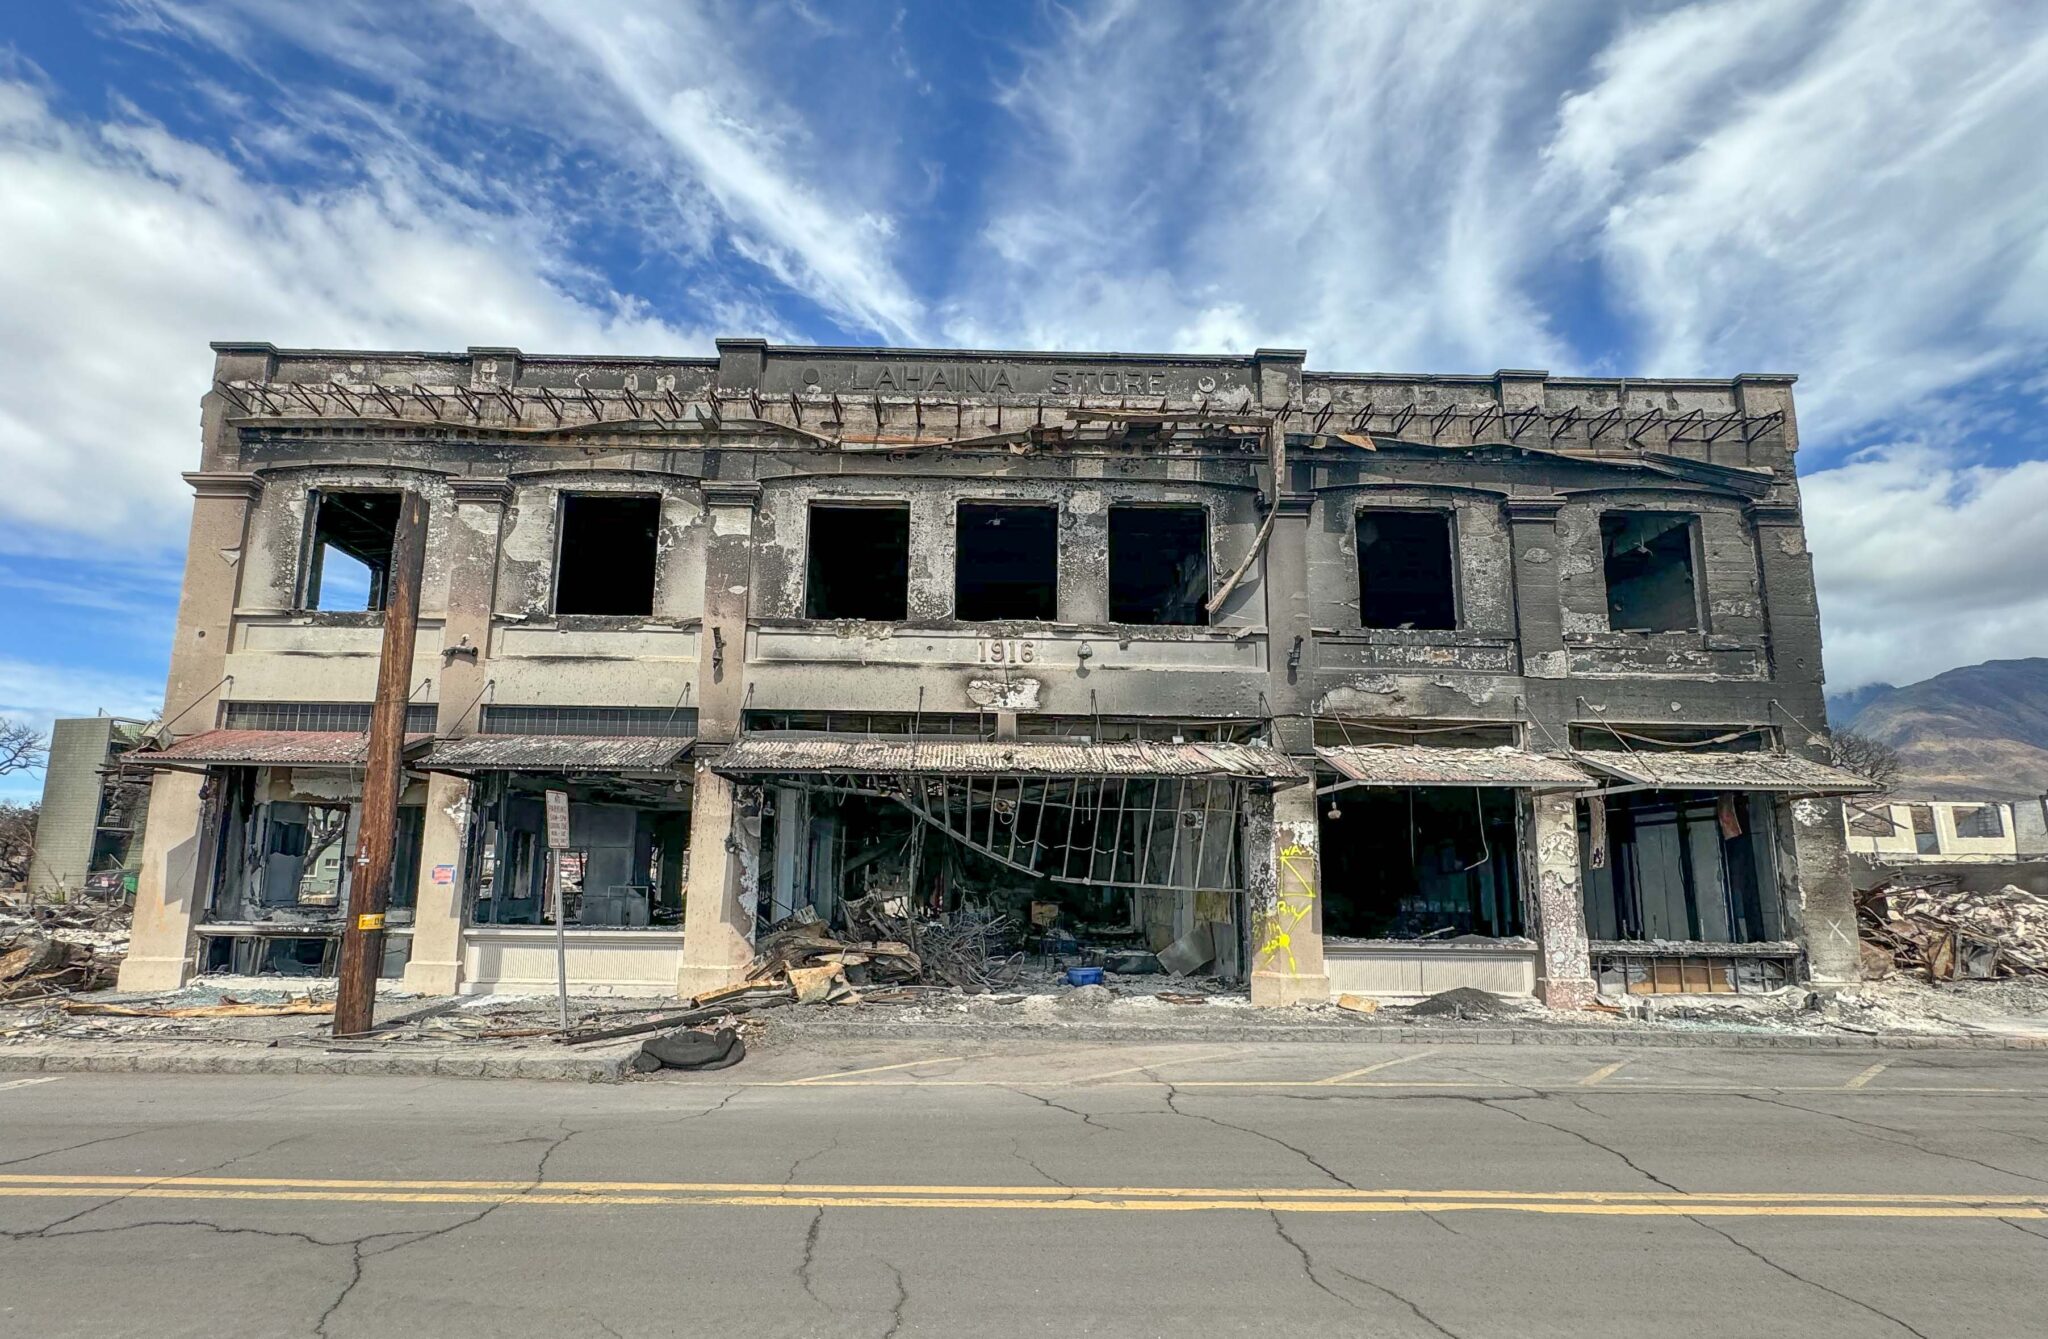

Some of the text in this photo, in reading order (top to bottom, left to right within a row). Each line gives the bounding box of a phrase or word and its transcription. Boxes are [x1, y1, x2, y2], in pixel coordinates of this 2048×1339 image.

[851, 364, 1166, 396] LAHAINA STORE
[979, 640, 1034, 662] 1916
